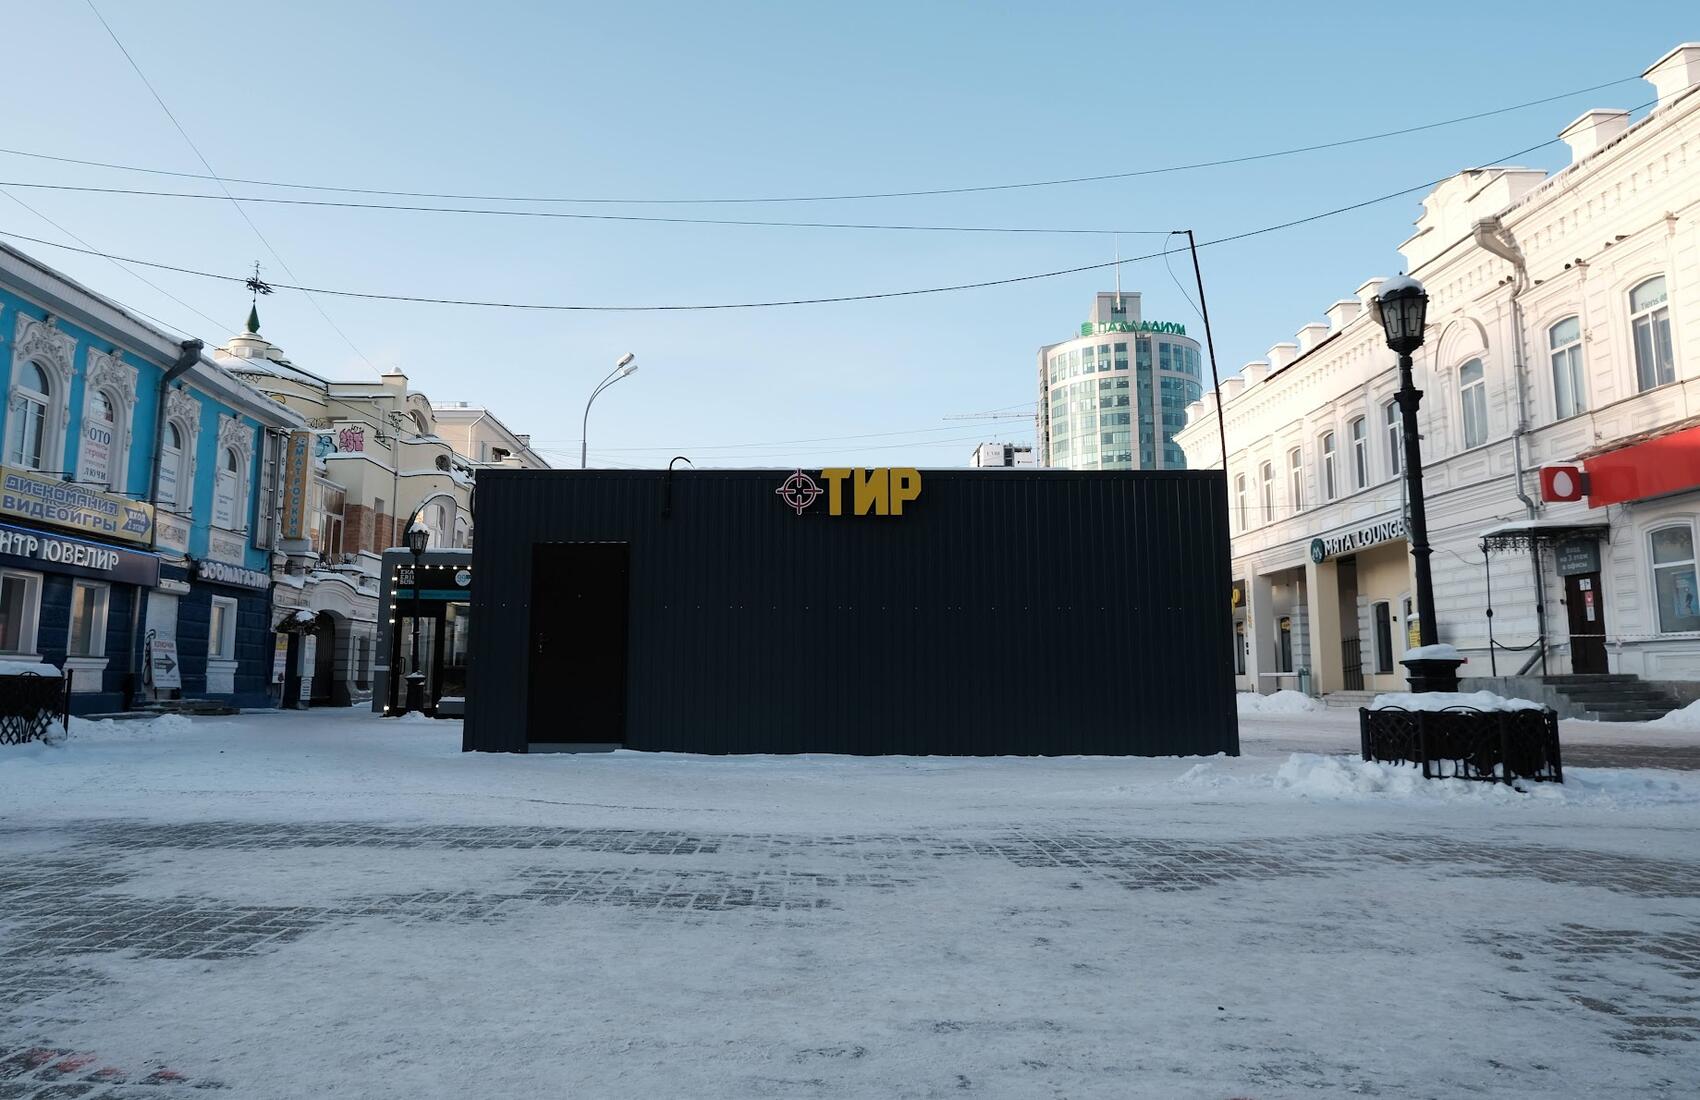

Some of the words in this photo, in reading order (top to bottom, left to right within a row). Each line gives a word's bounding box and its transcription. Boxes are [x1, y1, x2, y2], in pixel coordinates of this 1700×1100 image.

[1098, 319, 1187, 336] ПАЛЛАДИУМ
[88, 427, 111, 446] ОТО
[4, 473, 119, 516] ДИСКОМАНИЯ
[820, 467, 922, 516] ТИР
[41, 538, 119, 571] ЮВЕЛИР
[1324, 534, 1355, 557] МЯТА
